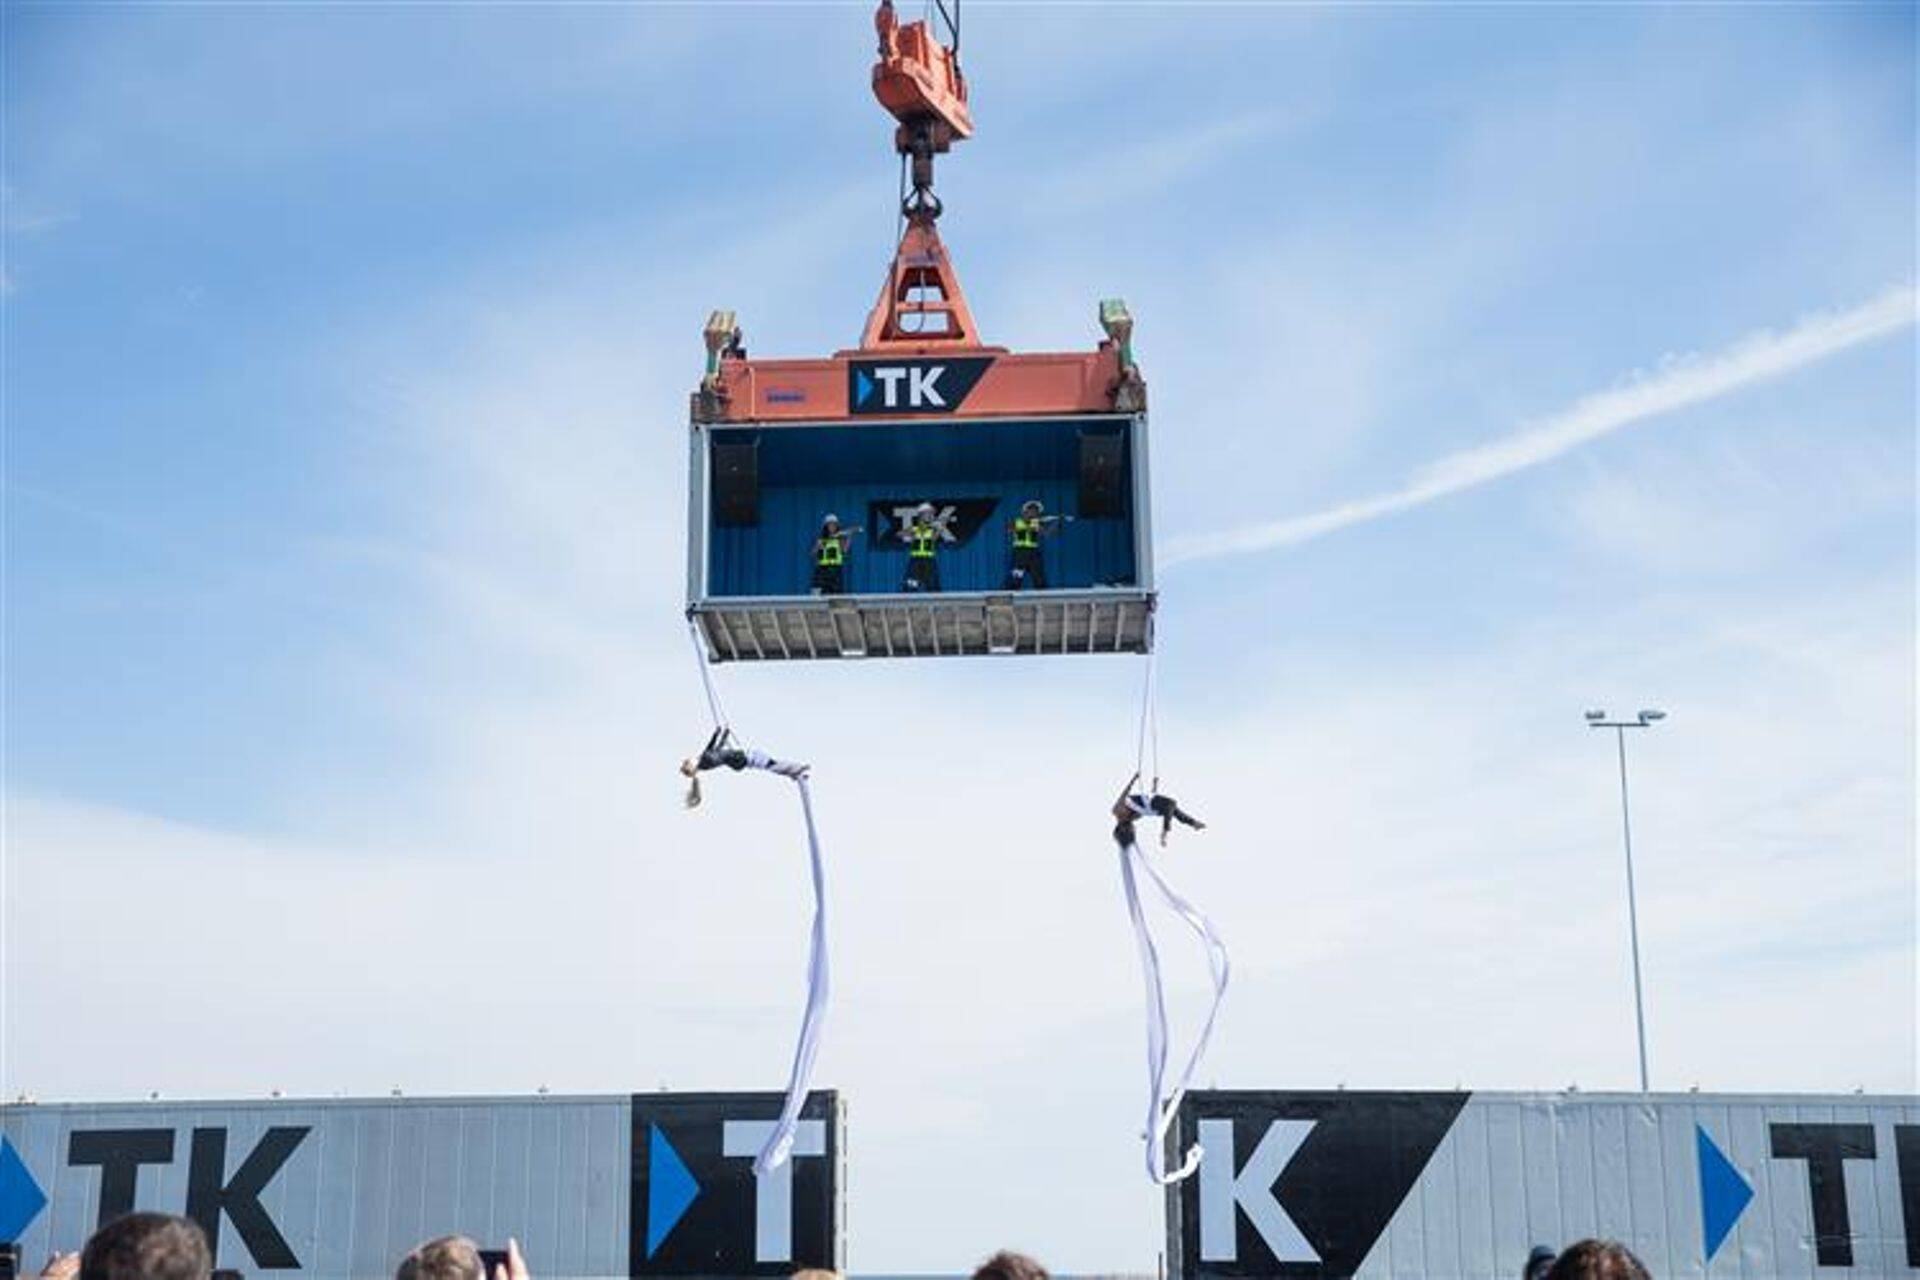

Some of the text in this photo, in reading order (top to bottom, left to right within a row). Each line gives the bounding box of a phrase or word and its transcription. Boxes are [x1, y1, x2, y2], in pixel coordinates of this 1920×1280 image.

[874, 367, 947, 407] TK
[67, 1126, 313, 1269] TK
[1769, 1123, 1919, 1268] T
